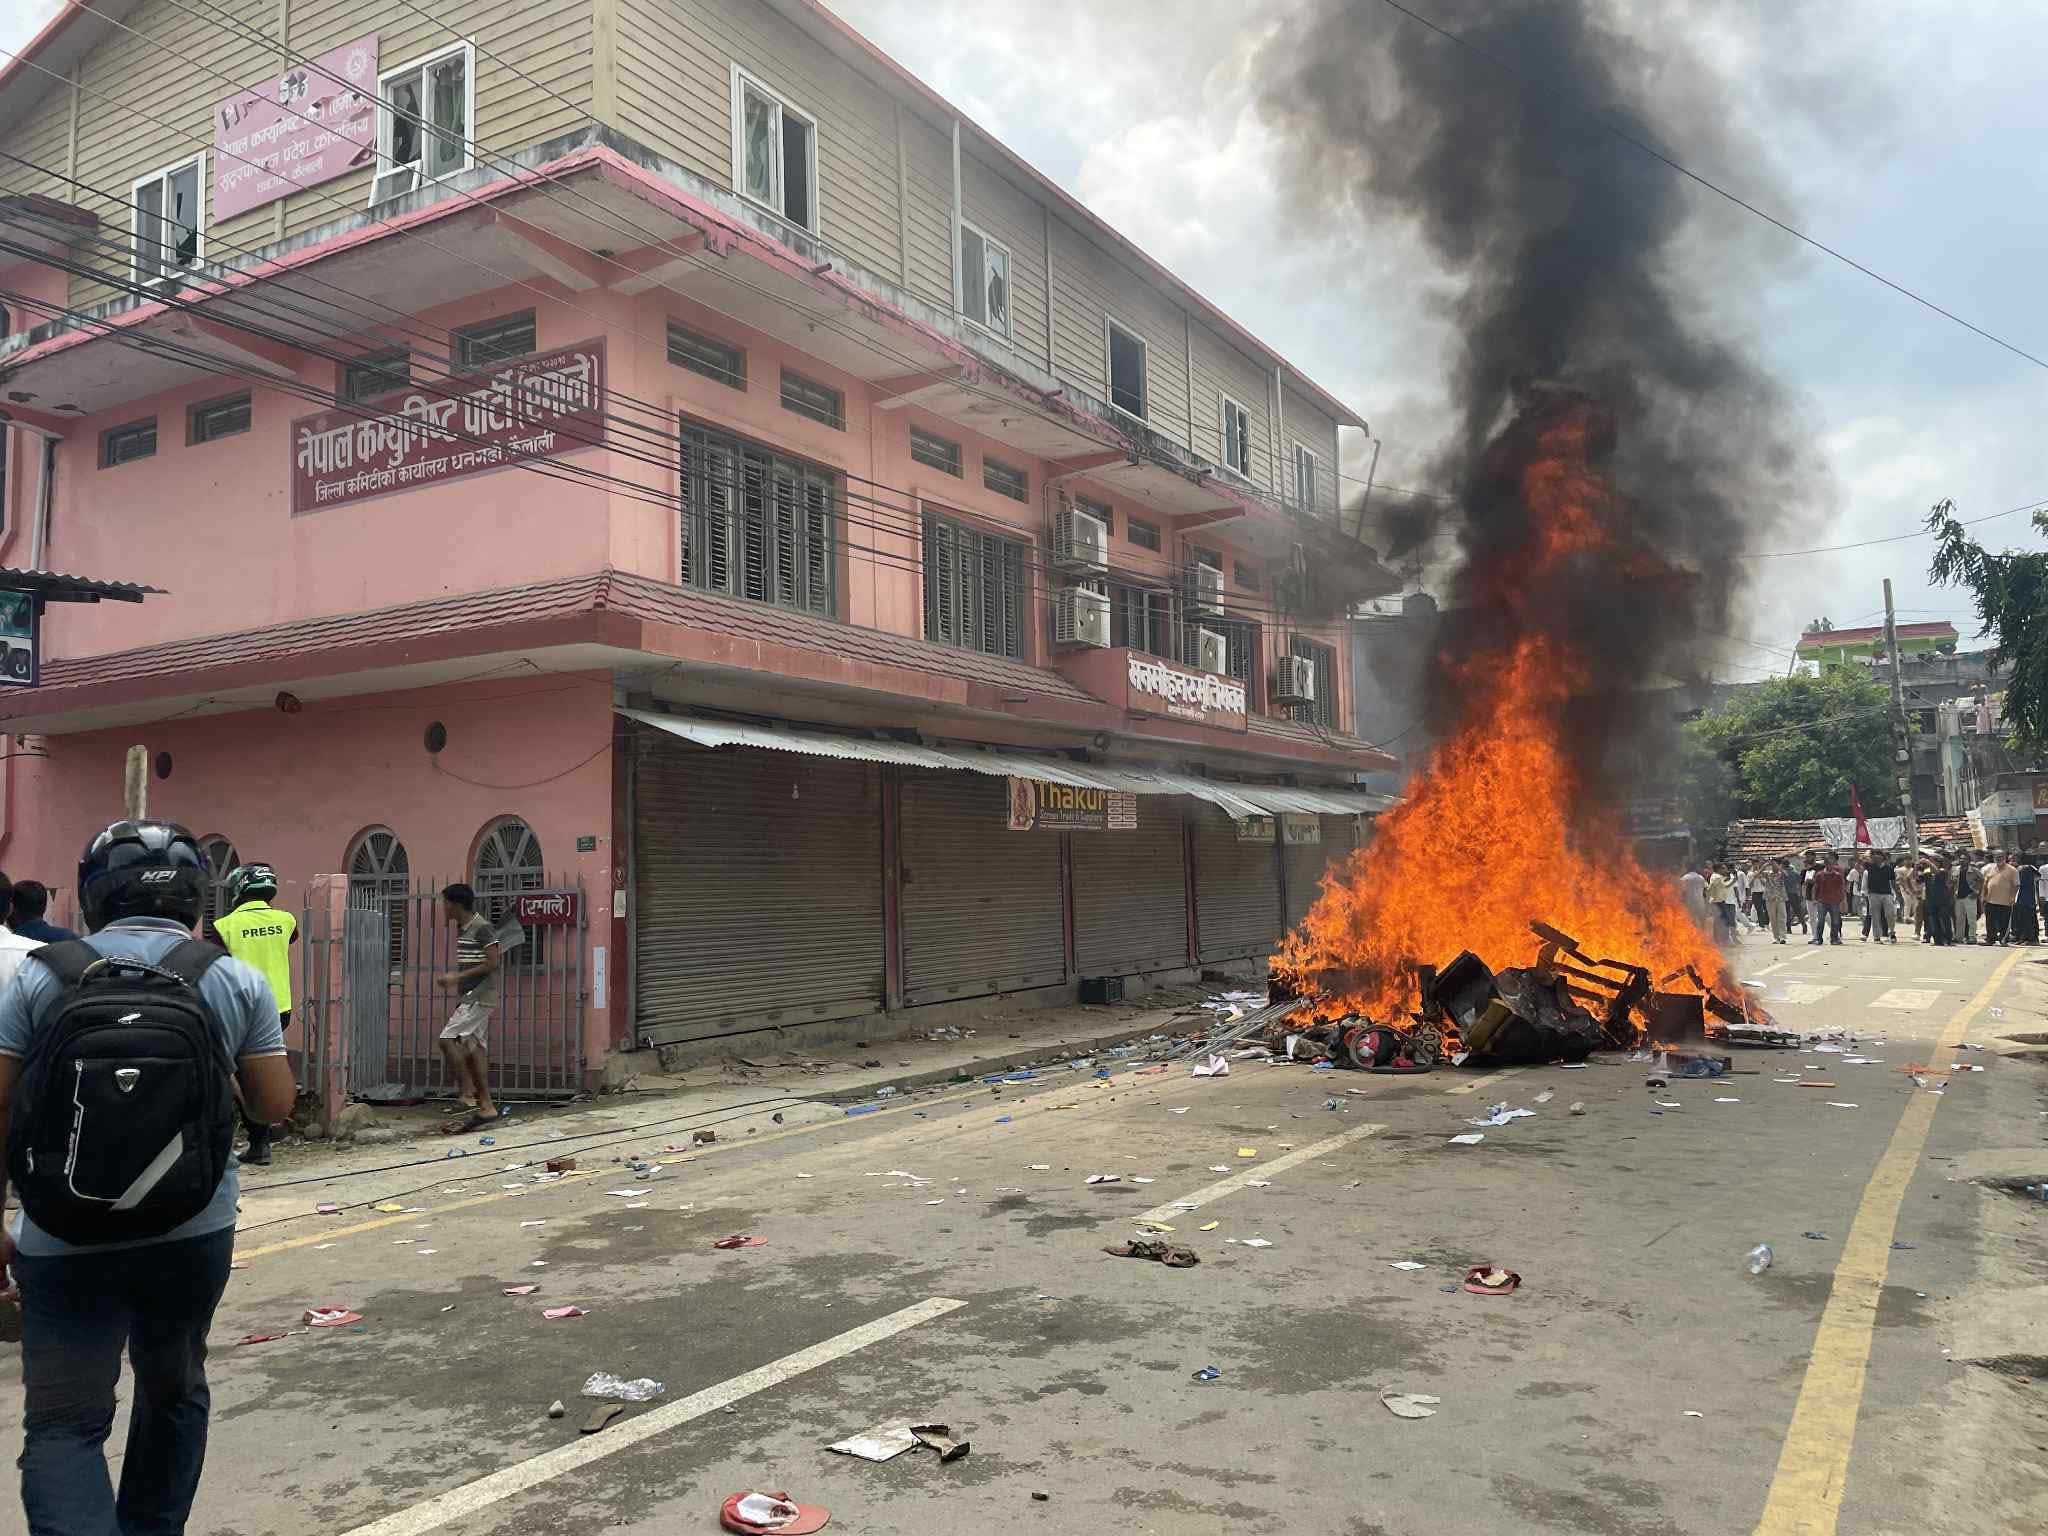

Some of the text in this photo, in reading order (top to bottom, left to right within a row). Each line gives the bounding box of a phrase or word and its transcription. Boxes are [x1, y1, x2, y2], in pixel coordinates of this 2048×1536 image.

[298, 424, 355, 477] नेपाल
[461, 369, 516, 436] पार्टी
[315, 480, 345, 503] जिल्ला
[347, 464, 396, 495] कमिटीको
[398, 456, 449, 483] कार्यालय
[1033, 781, 1106, 811] Thakur
[242, 925, 283, 939] PRESS
